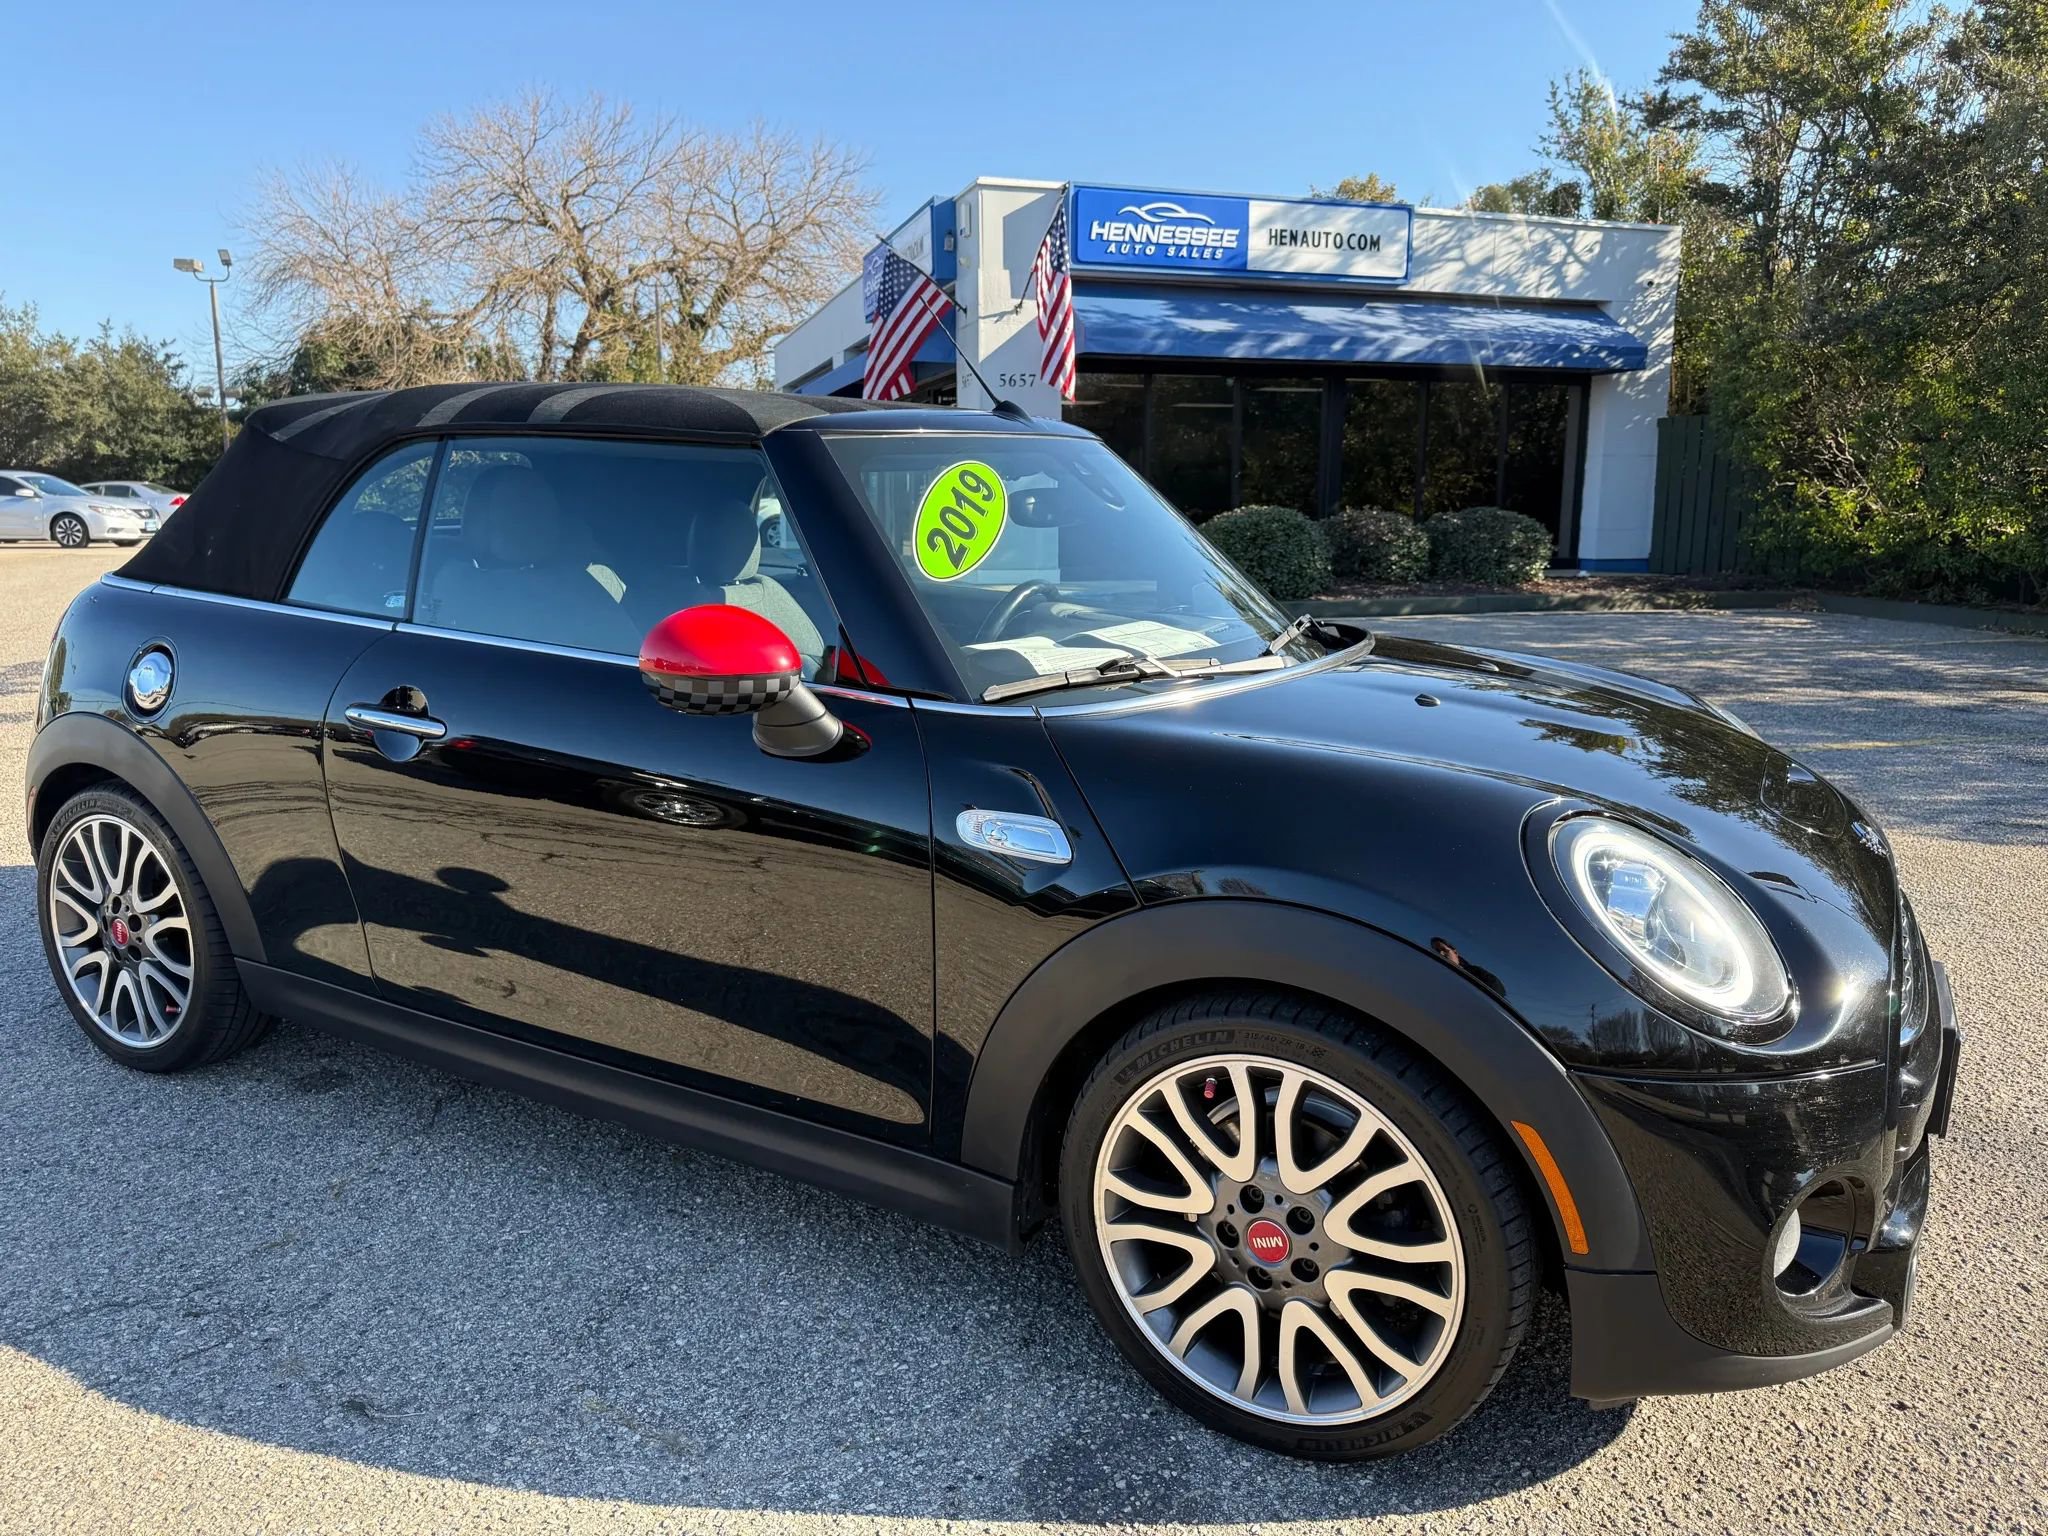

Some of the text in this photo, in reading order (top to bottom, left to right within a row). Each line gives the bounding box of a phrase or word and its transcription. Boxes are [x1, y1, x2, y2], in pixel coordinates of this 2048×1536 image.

[1090, 220, 1240, 248] HENNESSEE
[1106, 243, 1224, 260] AUTO SALES
[999, 373, 1036, 388] 5657
[927, 469, 997, 571] 2019
[1136, 1031, 1228, 1068] MICHELIN
[1252, 1236, 1284, 1249] MINI
